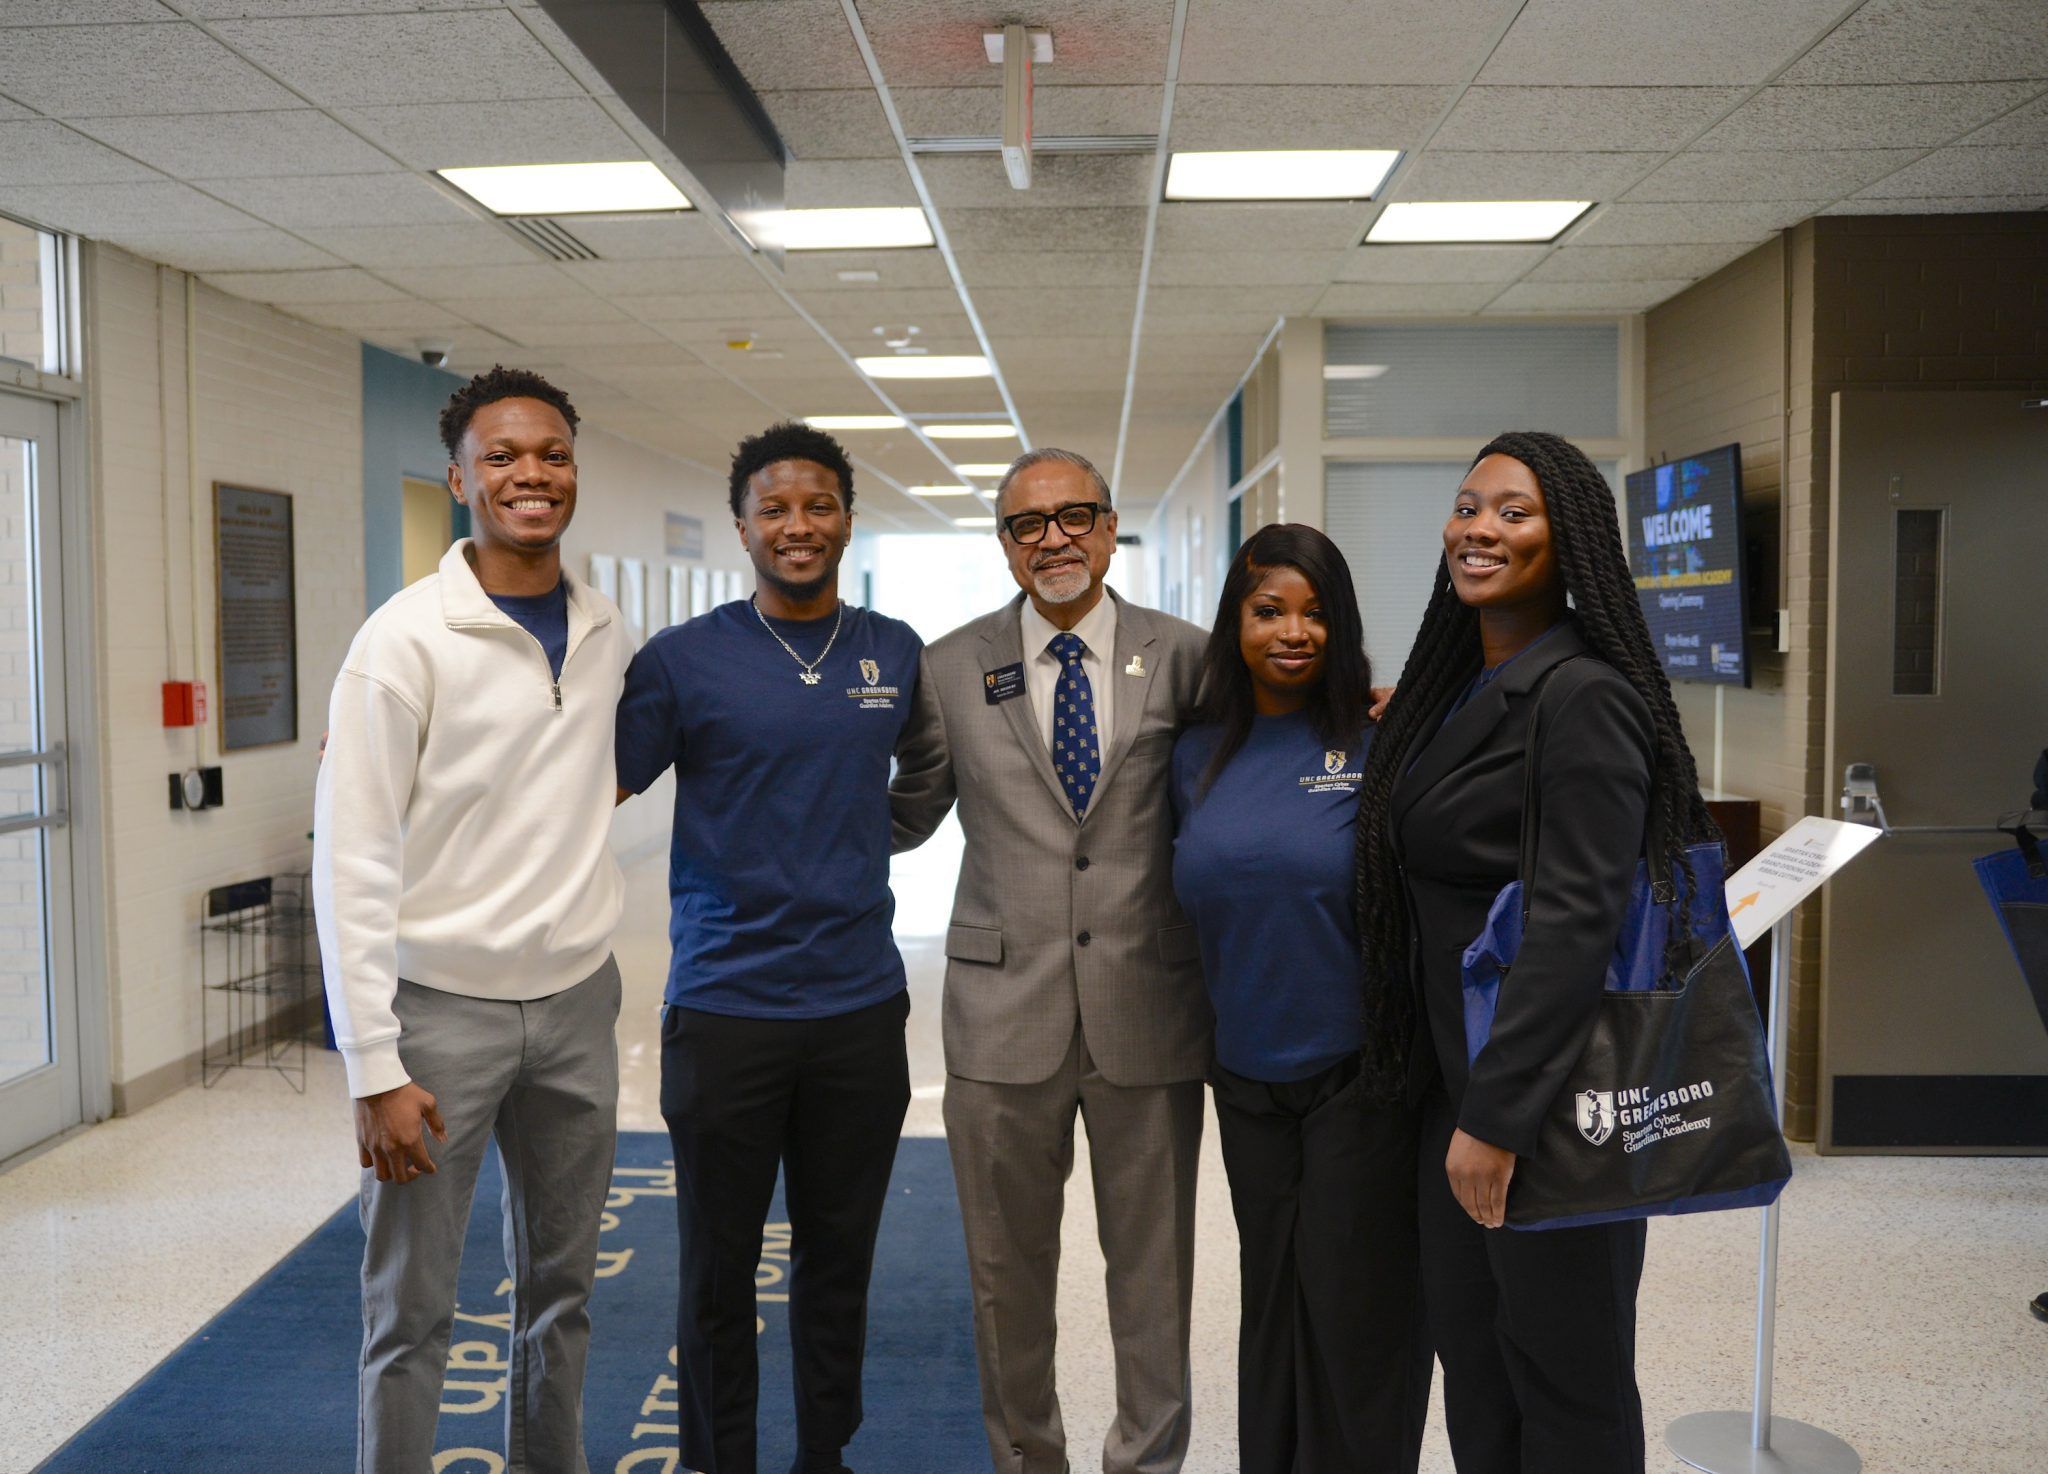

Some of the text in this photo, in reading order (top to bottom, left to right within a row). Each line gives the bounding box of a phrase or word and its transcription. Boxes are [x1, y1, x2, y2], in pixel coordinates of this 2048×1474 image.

[1642, 504, 1713, 548] WELCOME
[1316, 773, 1362, 781] GREENSBOR
[1617, 1086, 1650, 1107] UNC
[1619, 1080, 1714, 1126] GREENSBORO
[1622, 1112, 1681, 1144] Spartan Cyber
[1623, 1116, 1711, 1154] Guardian Academy
